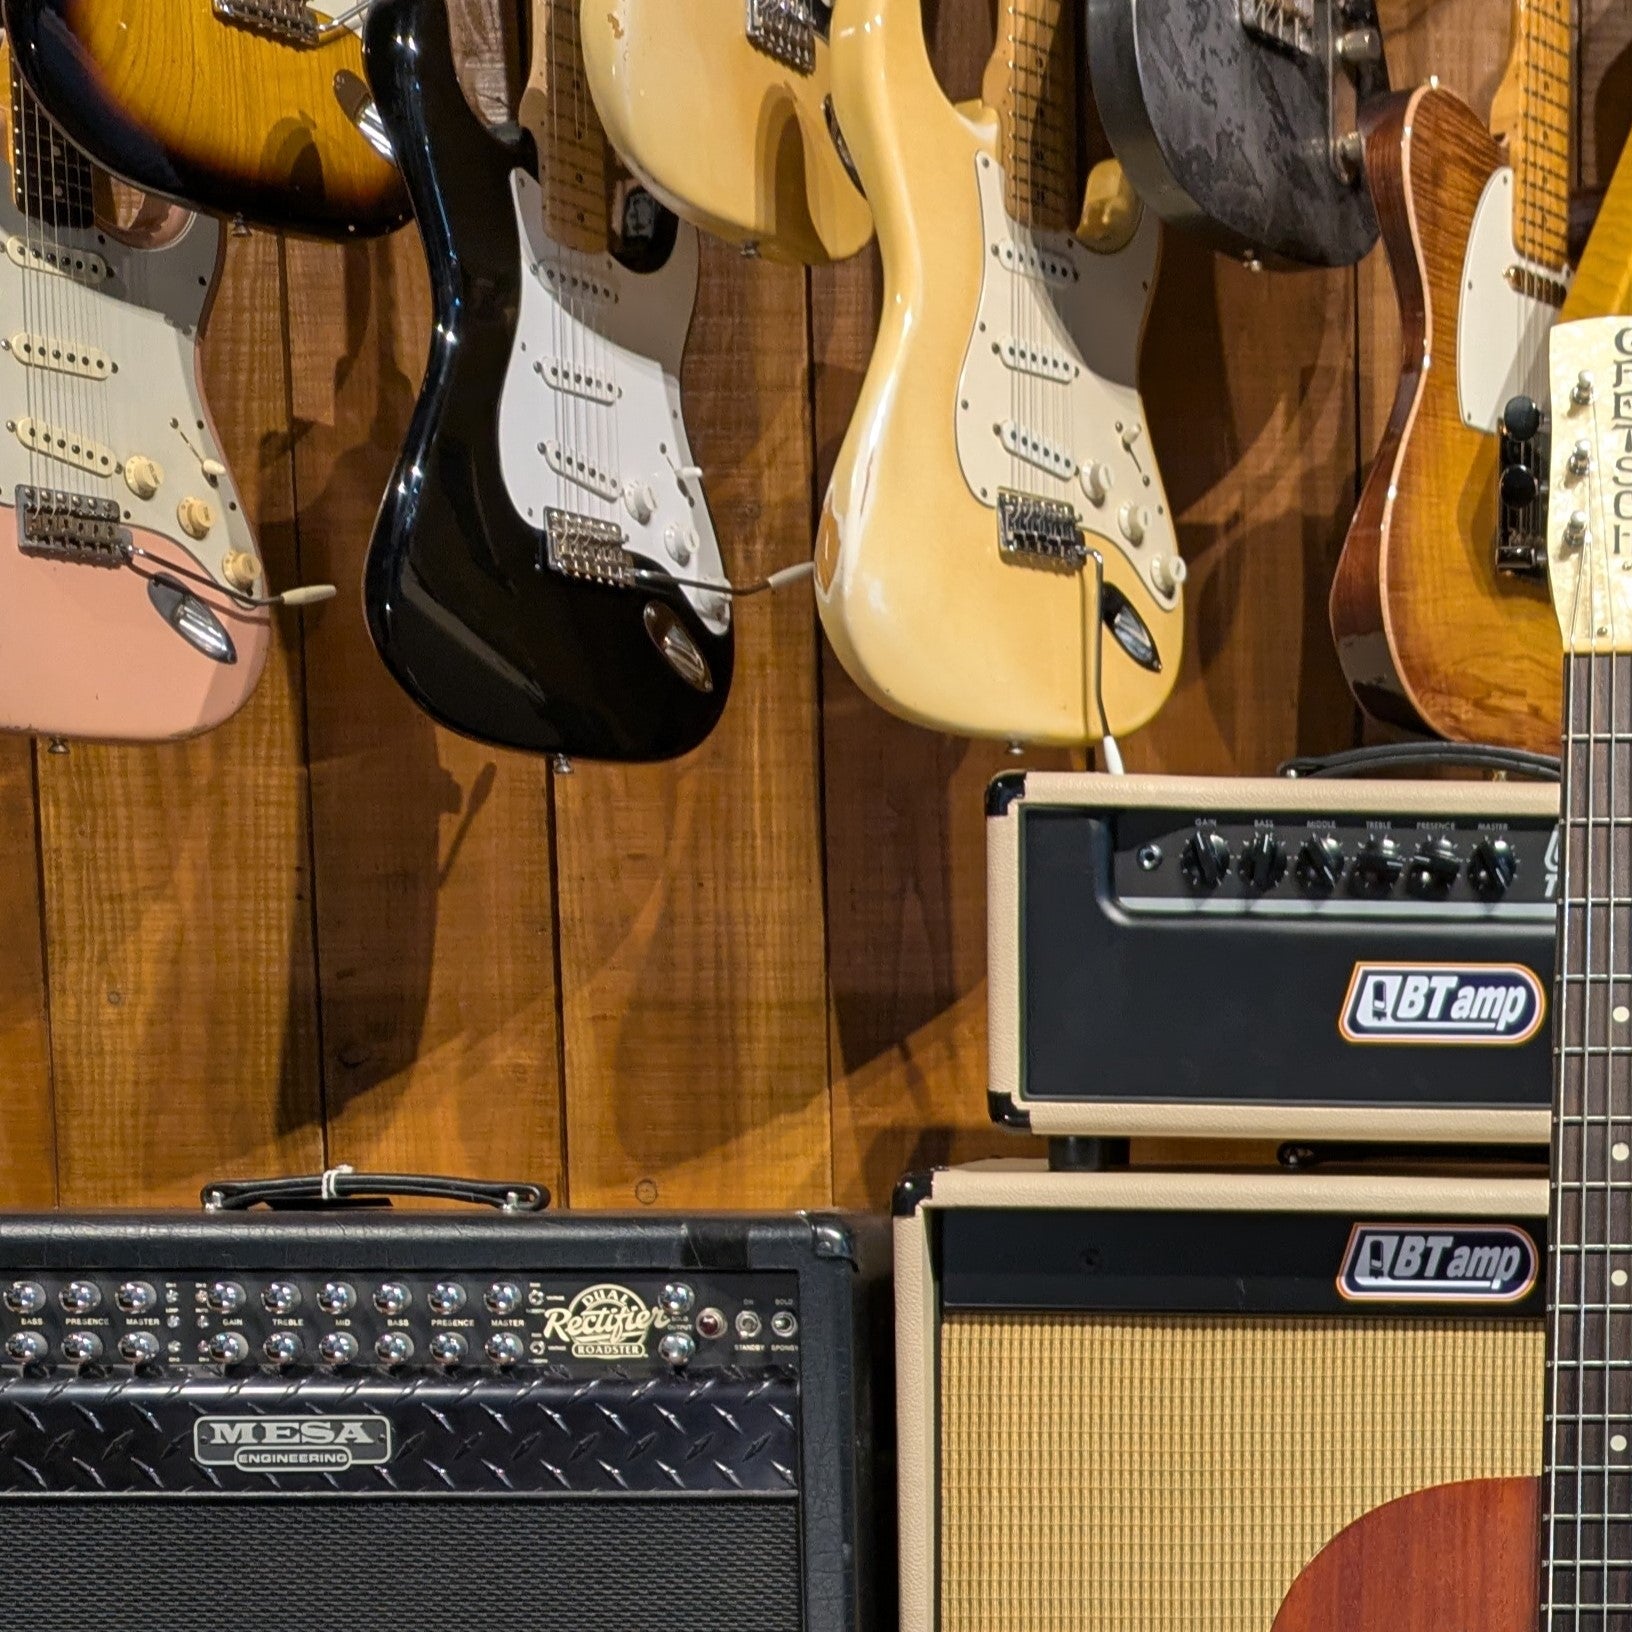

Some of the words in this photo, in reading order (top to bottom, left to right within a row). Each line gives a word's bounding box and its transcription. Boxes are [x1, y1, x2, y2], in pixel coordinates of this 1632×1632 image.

[1195, 818, 1217, 827] GAIN
[1254, 819, 1273, 828] BASS
[1307, 820, 1336, 829] MIDDLE
[1366, 821, 1392, 830] TREBLE
[1417, 821, 1455, 830] PRESENCE
[1478, 823, 1508, 831] MASTER
[1450, 985, 1526, 1031] amp
[1446, 1245, 1521, 1290] amp
[581, 1289, 629, 1310] DUAL
[21, 1318, 43, 1326] BASS
[65, 1318, 109, 1326] PRESENCE
[126, 1318, 160, 1326] MASTER
[222, 1318, 243, 1326] GAIN
[272, 1318, 304, 1326] TREBLE
[335, 1318, 351, 1326] MID
[387, 1318, 409, 1327] BASS
[431, 1318, 475, 1327] PRESENCE
[491, 1318, 525, 1327] MASTER
[543, 1305, 671, 1344] Rectifier
[577, 1345, 639, 1354] ROADSTER
[209, 1422, 374, 1444] MESA
[238, 1453, 348, 1463] ENGINEERING
